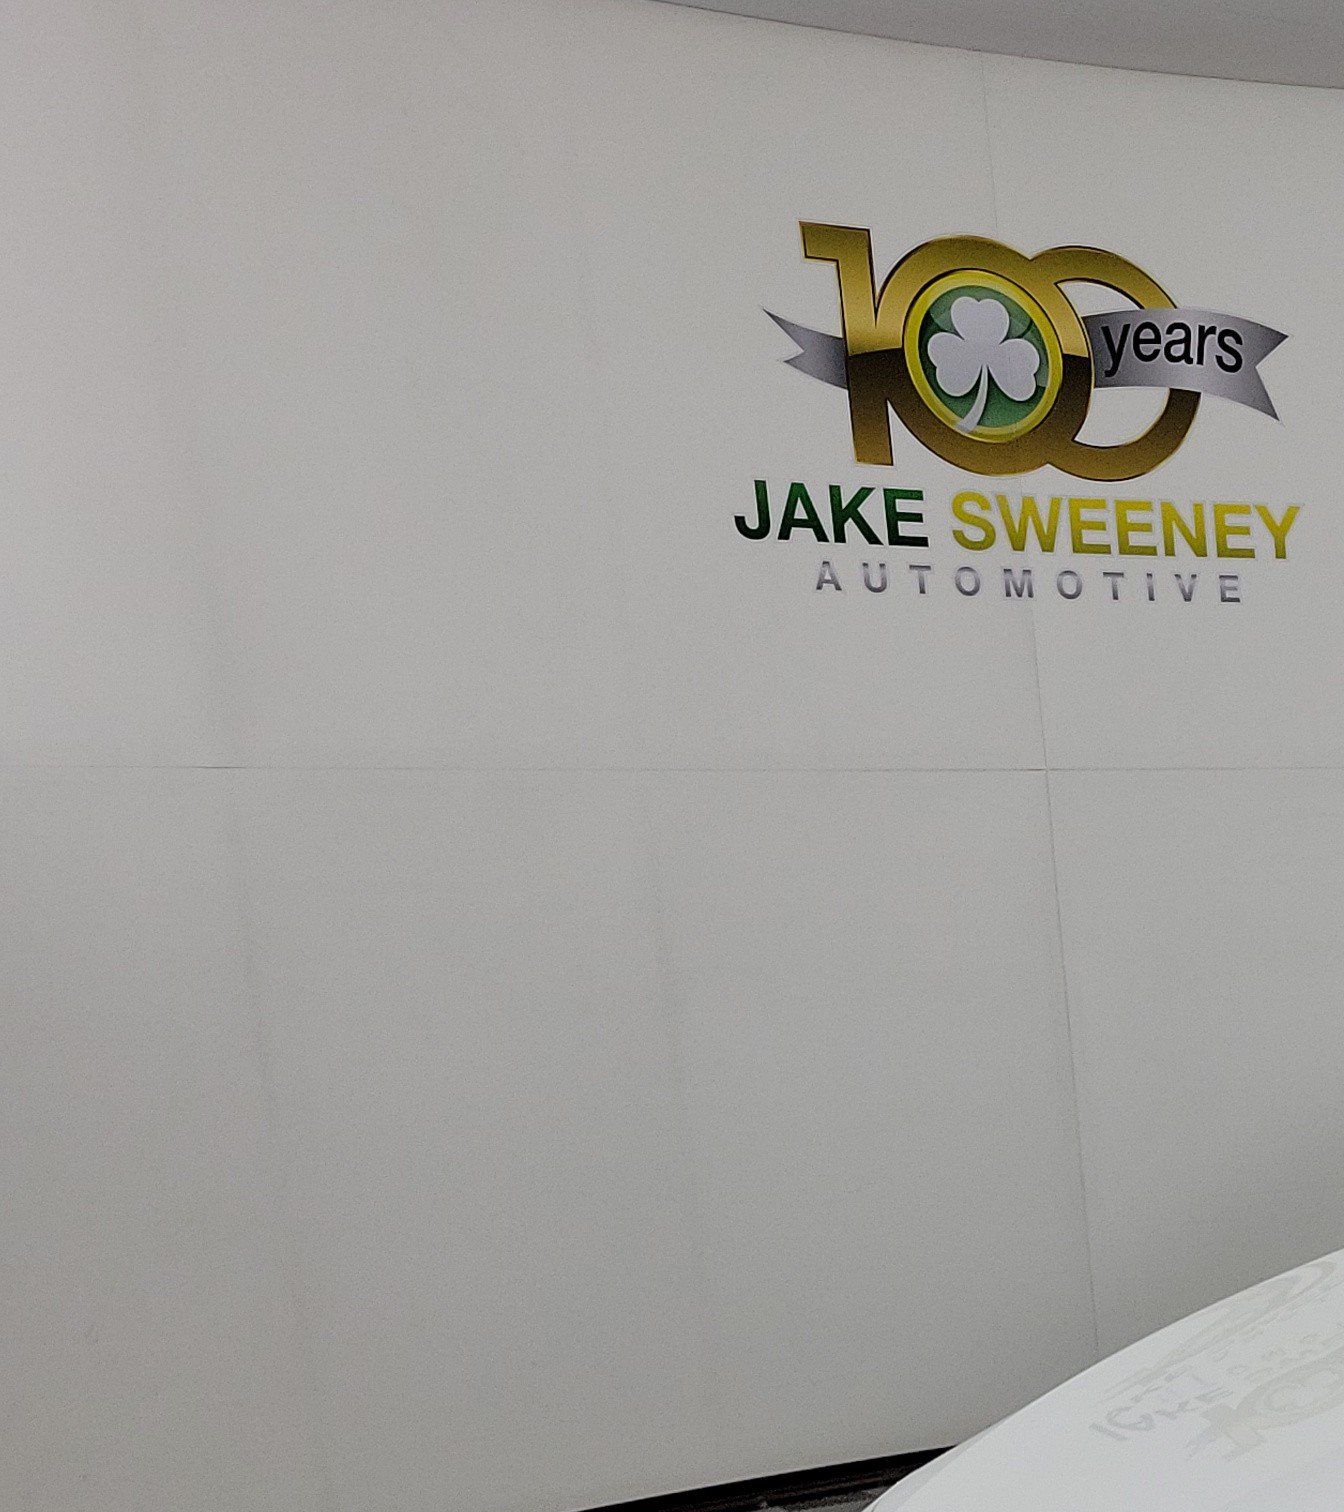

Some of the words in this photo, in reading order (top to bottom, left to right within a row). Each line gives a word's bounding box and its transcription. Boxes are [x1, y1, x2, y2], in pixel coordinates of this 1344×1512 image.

[799, 220, 1201, 482] 100
[1100, 321, 1244, 378] years
[733, 479, 930, 548] JAKE
[950, 490, 1302, 560] SWEENEY
[814, 560, 1242, 603] AUTOMOTIVE
